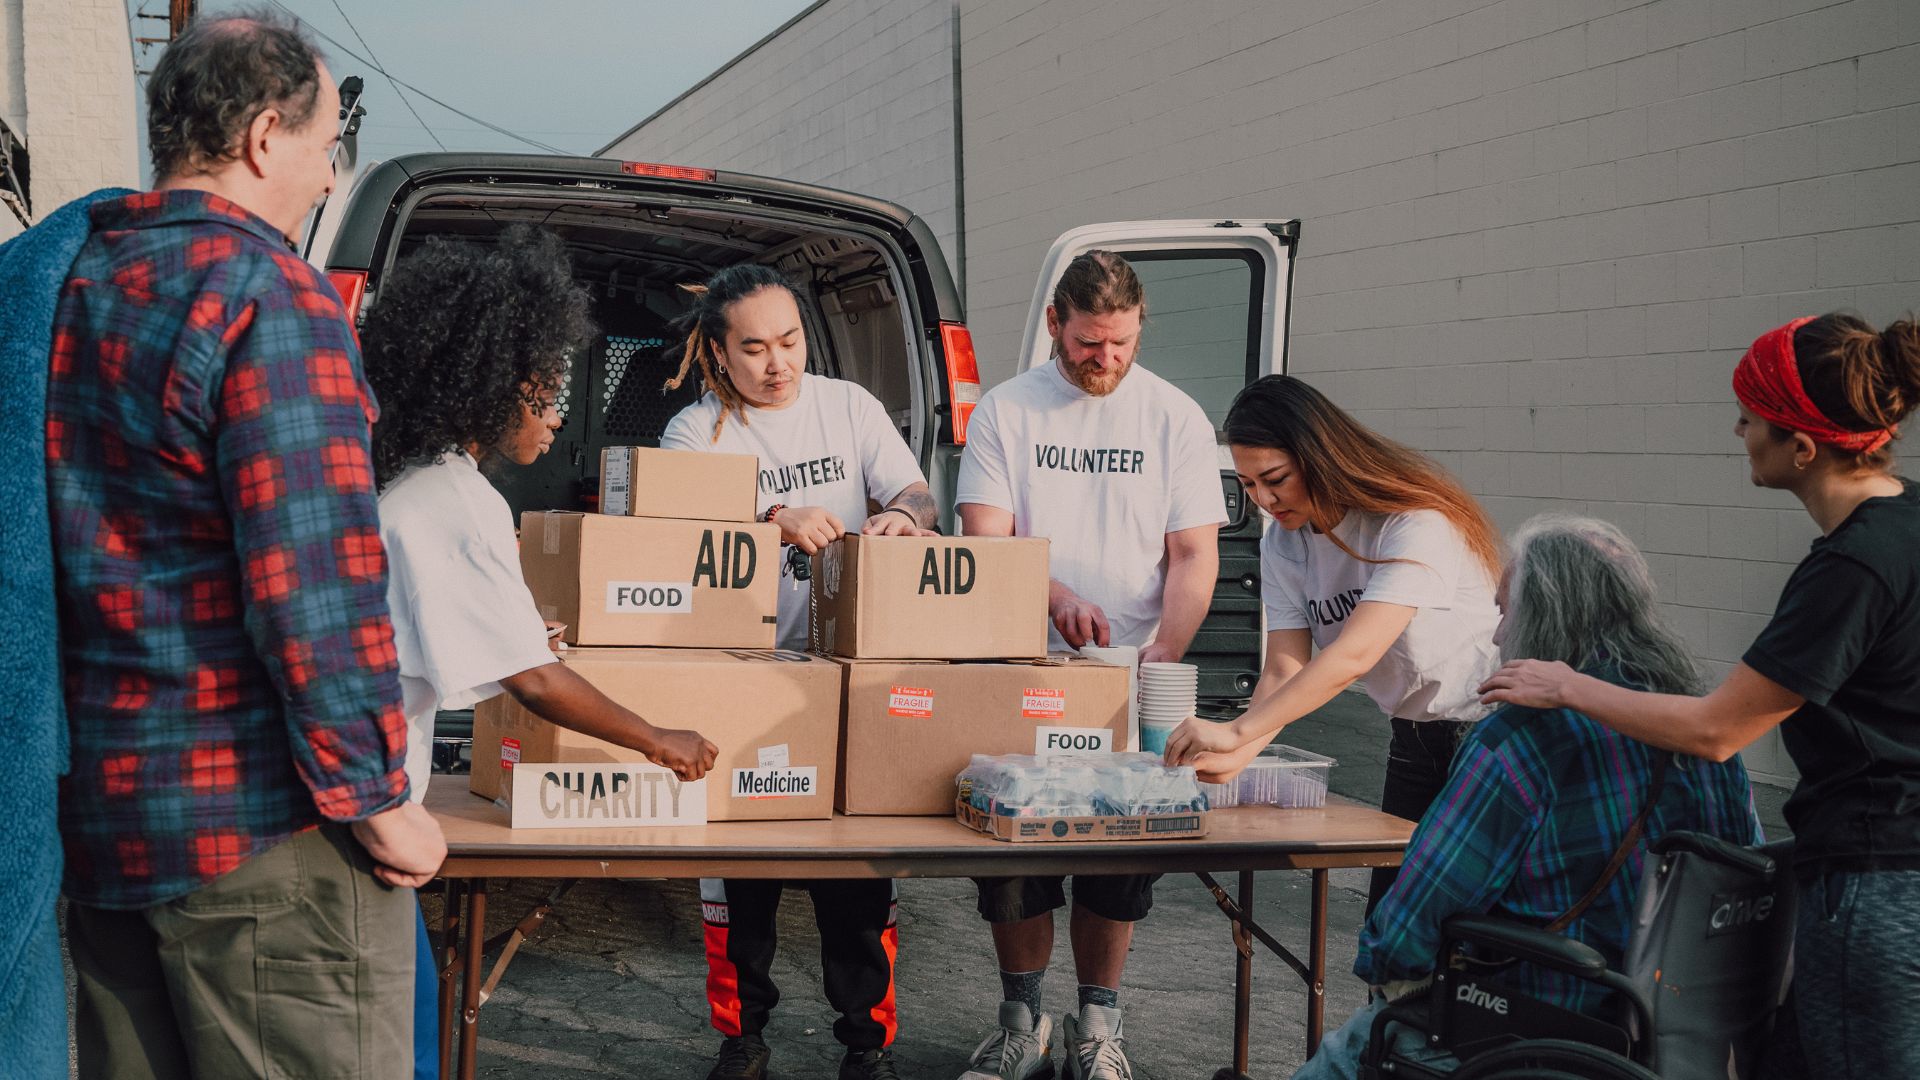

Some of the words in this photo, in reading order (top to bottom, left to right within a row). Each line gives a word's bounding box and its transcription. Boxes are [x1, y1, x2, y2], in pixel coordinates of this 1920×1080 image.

[1035, 443, 1145, 475] VOLUNTEER
[759, 456, 846, 495] OLUNTEER
[692, 529, 757, 589] AID
[918, 547, 976, 595] AID
[617, 586, 683, 607] FOOD
[893, 697, 929, 708] FRAGILE
[1026, 699, 1061, 708] FRAGILE
[1047, 733, 1102, 751] FOOD
[539, 770, 684, 819] CHARITY
[738, 770, 810, 794] Medicine
[702, 904, 730, 924] ARVEL
[1711, 894, 1774, 930] drive
[1456, 982, 1509, 1015] drive
